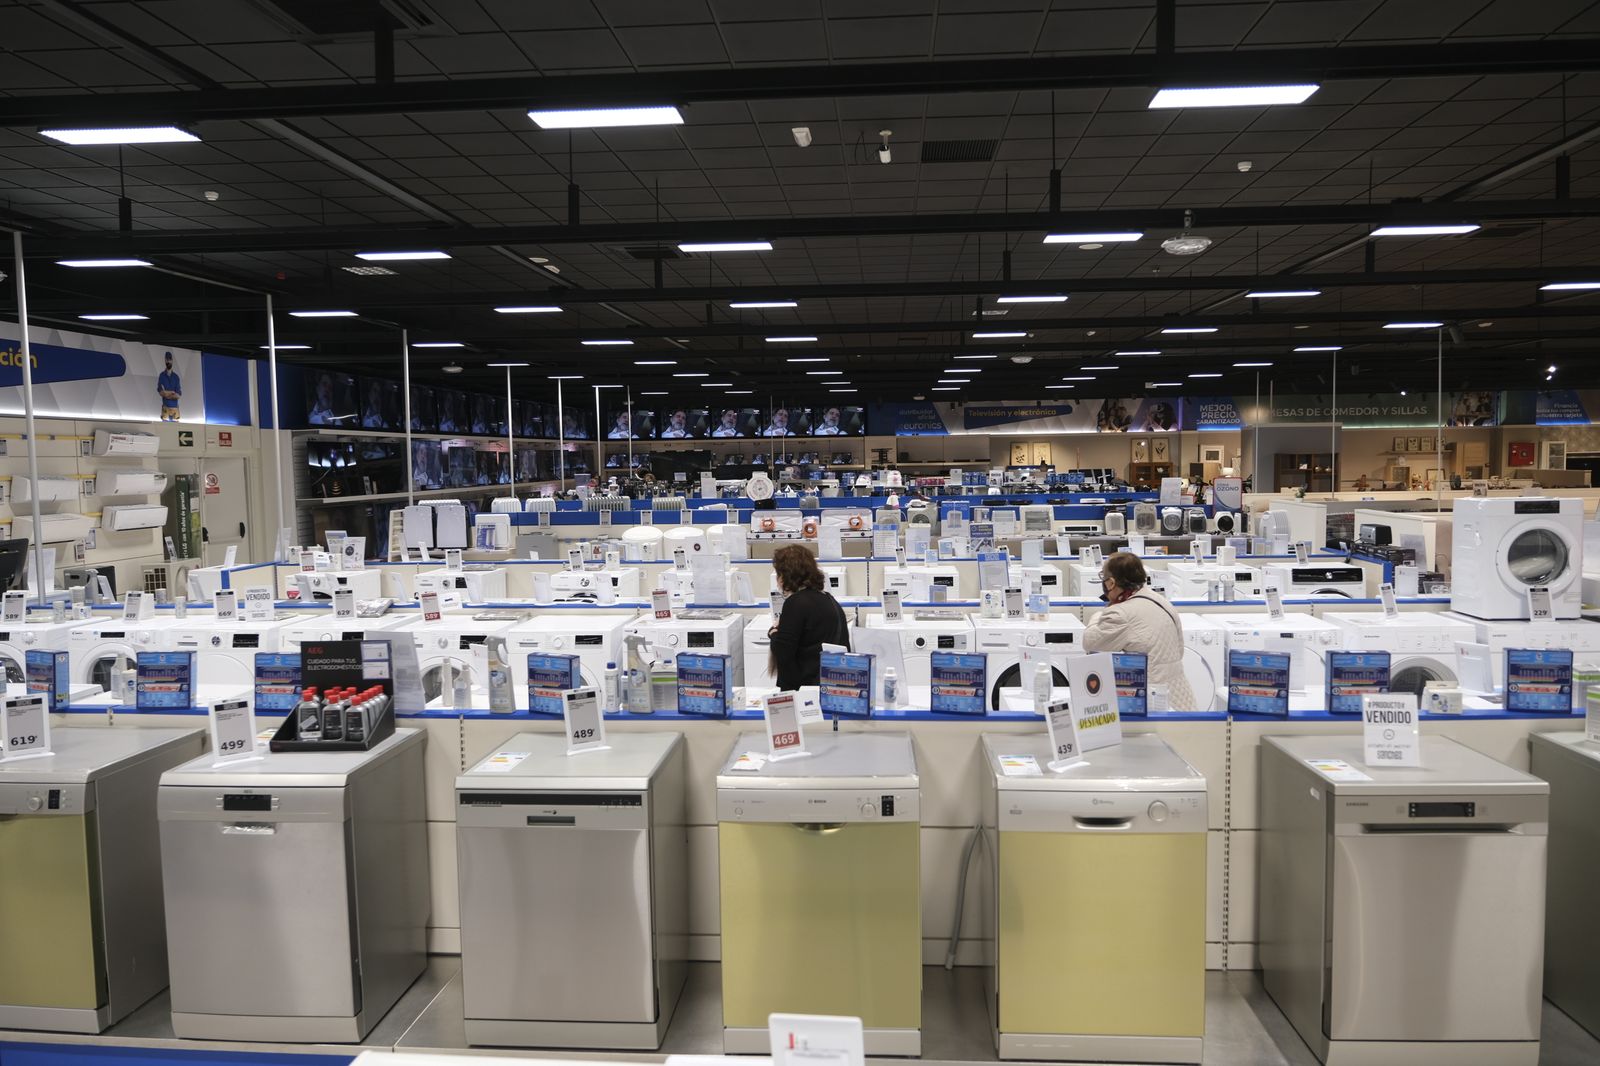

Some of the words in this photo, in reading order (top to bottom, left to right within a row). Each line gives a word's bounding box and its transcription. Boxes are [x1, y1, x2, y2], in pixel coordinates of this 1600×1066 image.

[968, 409, 1006, 417] Televisión
[1200, 404, 1233, 412] MEJOR
[1306, 407, 1321, 417] DE
[1324, 407, 1381, 417] COMEDOR
[1382, 407, 1389, 416] Y
[1391, 406, 1428, 416] SILLAS
[1201, 411, 1237, 419] PRECIO
[903, 420, 943, 430] euronics
[245, 593, 271, 601] VENDIDO
[1084, 703, 1109, 715] PRODUCTO
[1079, 712, 1117, 729] DESTACADO
[1365, 710, 1412, 724] VENDIDO
